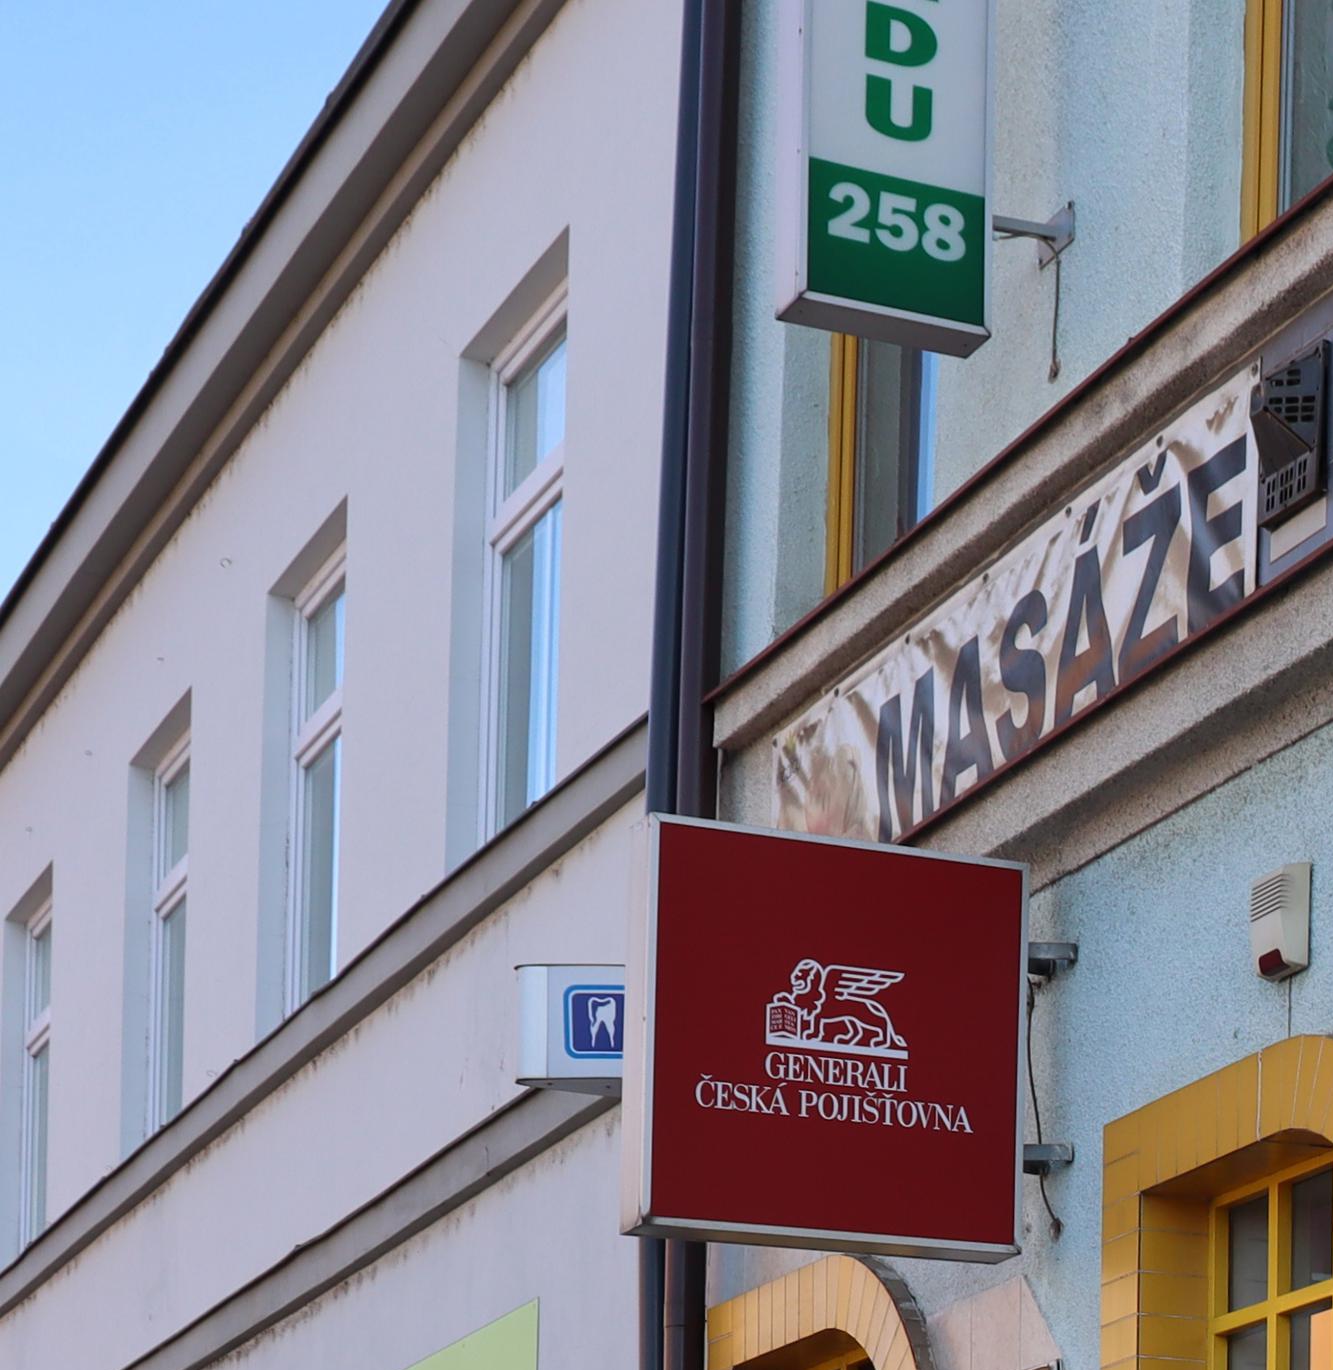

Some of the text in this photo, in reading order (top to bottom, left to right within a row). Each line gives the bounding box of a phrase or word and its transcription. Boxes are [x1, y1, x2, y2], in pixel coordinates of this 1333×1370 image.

[864, 0, 938, 142] DU
[828, 182, 966, 262] 258
[876, 433, 1247, 842] MASÁŽE
[695, 1073, 974, 1134] ČESKÁ POJIŠŤOVNA
[765, 1051, 909, 1092] GENERALI
